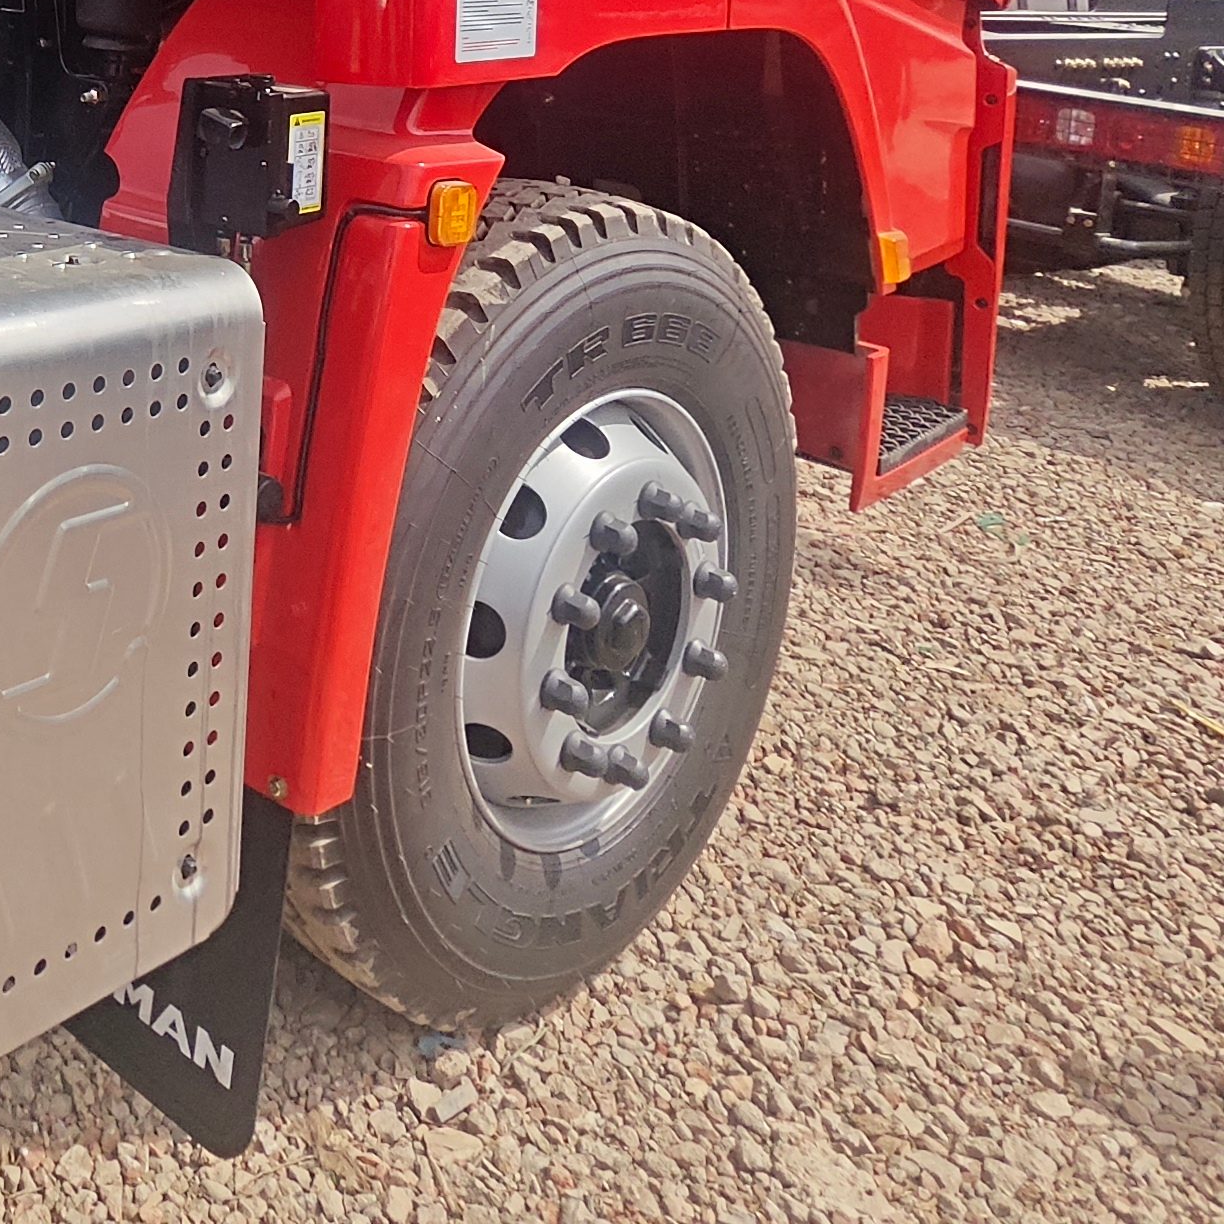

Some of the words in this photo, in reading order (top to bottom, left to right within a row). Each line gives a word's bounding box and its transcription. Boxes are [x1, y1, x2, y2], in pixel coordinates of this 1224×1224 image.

[519, 326, 611, 414] TR
[430, 783, 718, 950] TRIANGLE
[113, 982, 235, 1090] MAN
